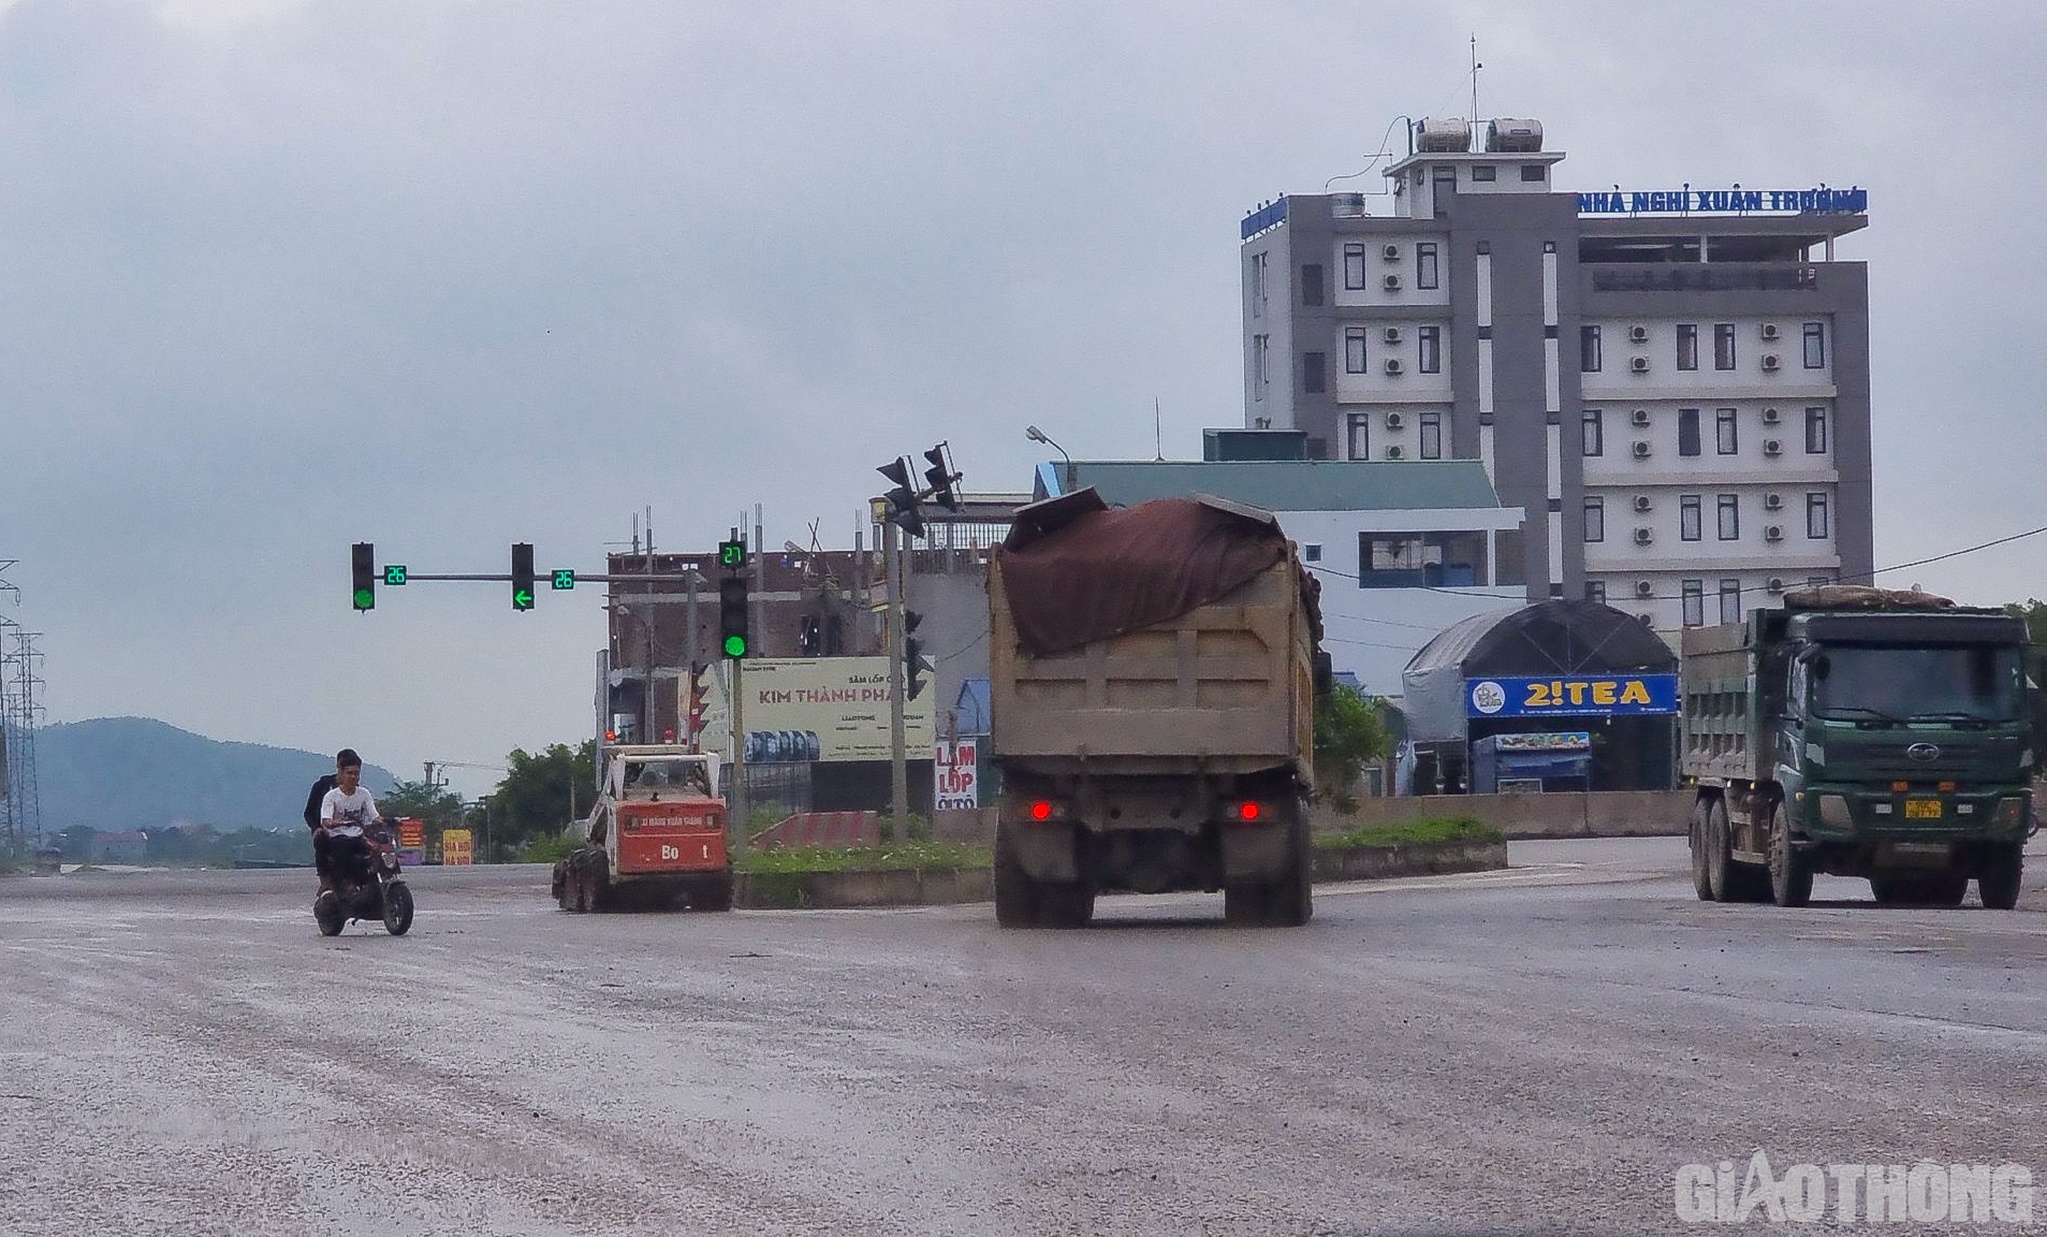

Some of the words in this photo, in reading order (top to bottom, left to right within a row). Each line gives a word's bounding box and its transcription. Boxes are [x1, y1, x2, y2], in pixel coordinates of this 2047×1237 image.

[1577, 184, 1624, 212] NHÀ
[1633, 183, 1689, 212] NGHỈ
[1698, 183, 1762, 212] XUÂN
[724, 546, 741, 563] 27
[387, 567, 405, 583] 26
[555, 571, 573, 588] 26
[759, 690, 791, 704] KIM
[796, 686, 856, 704] THÀNH
[1523, 680, 1651, 706] 2!TEA
